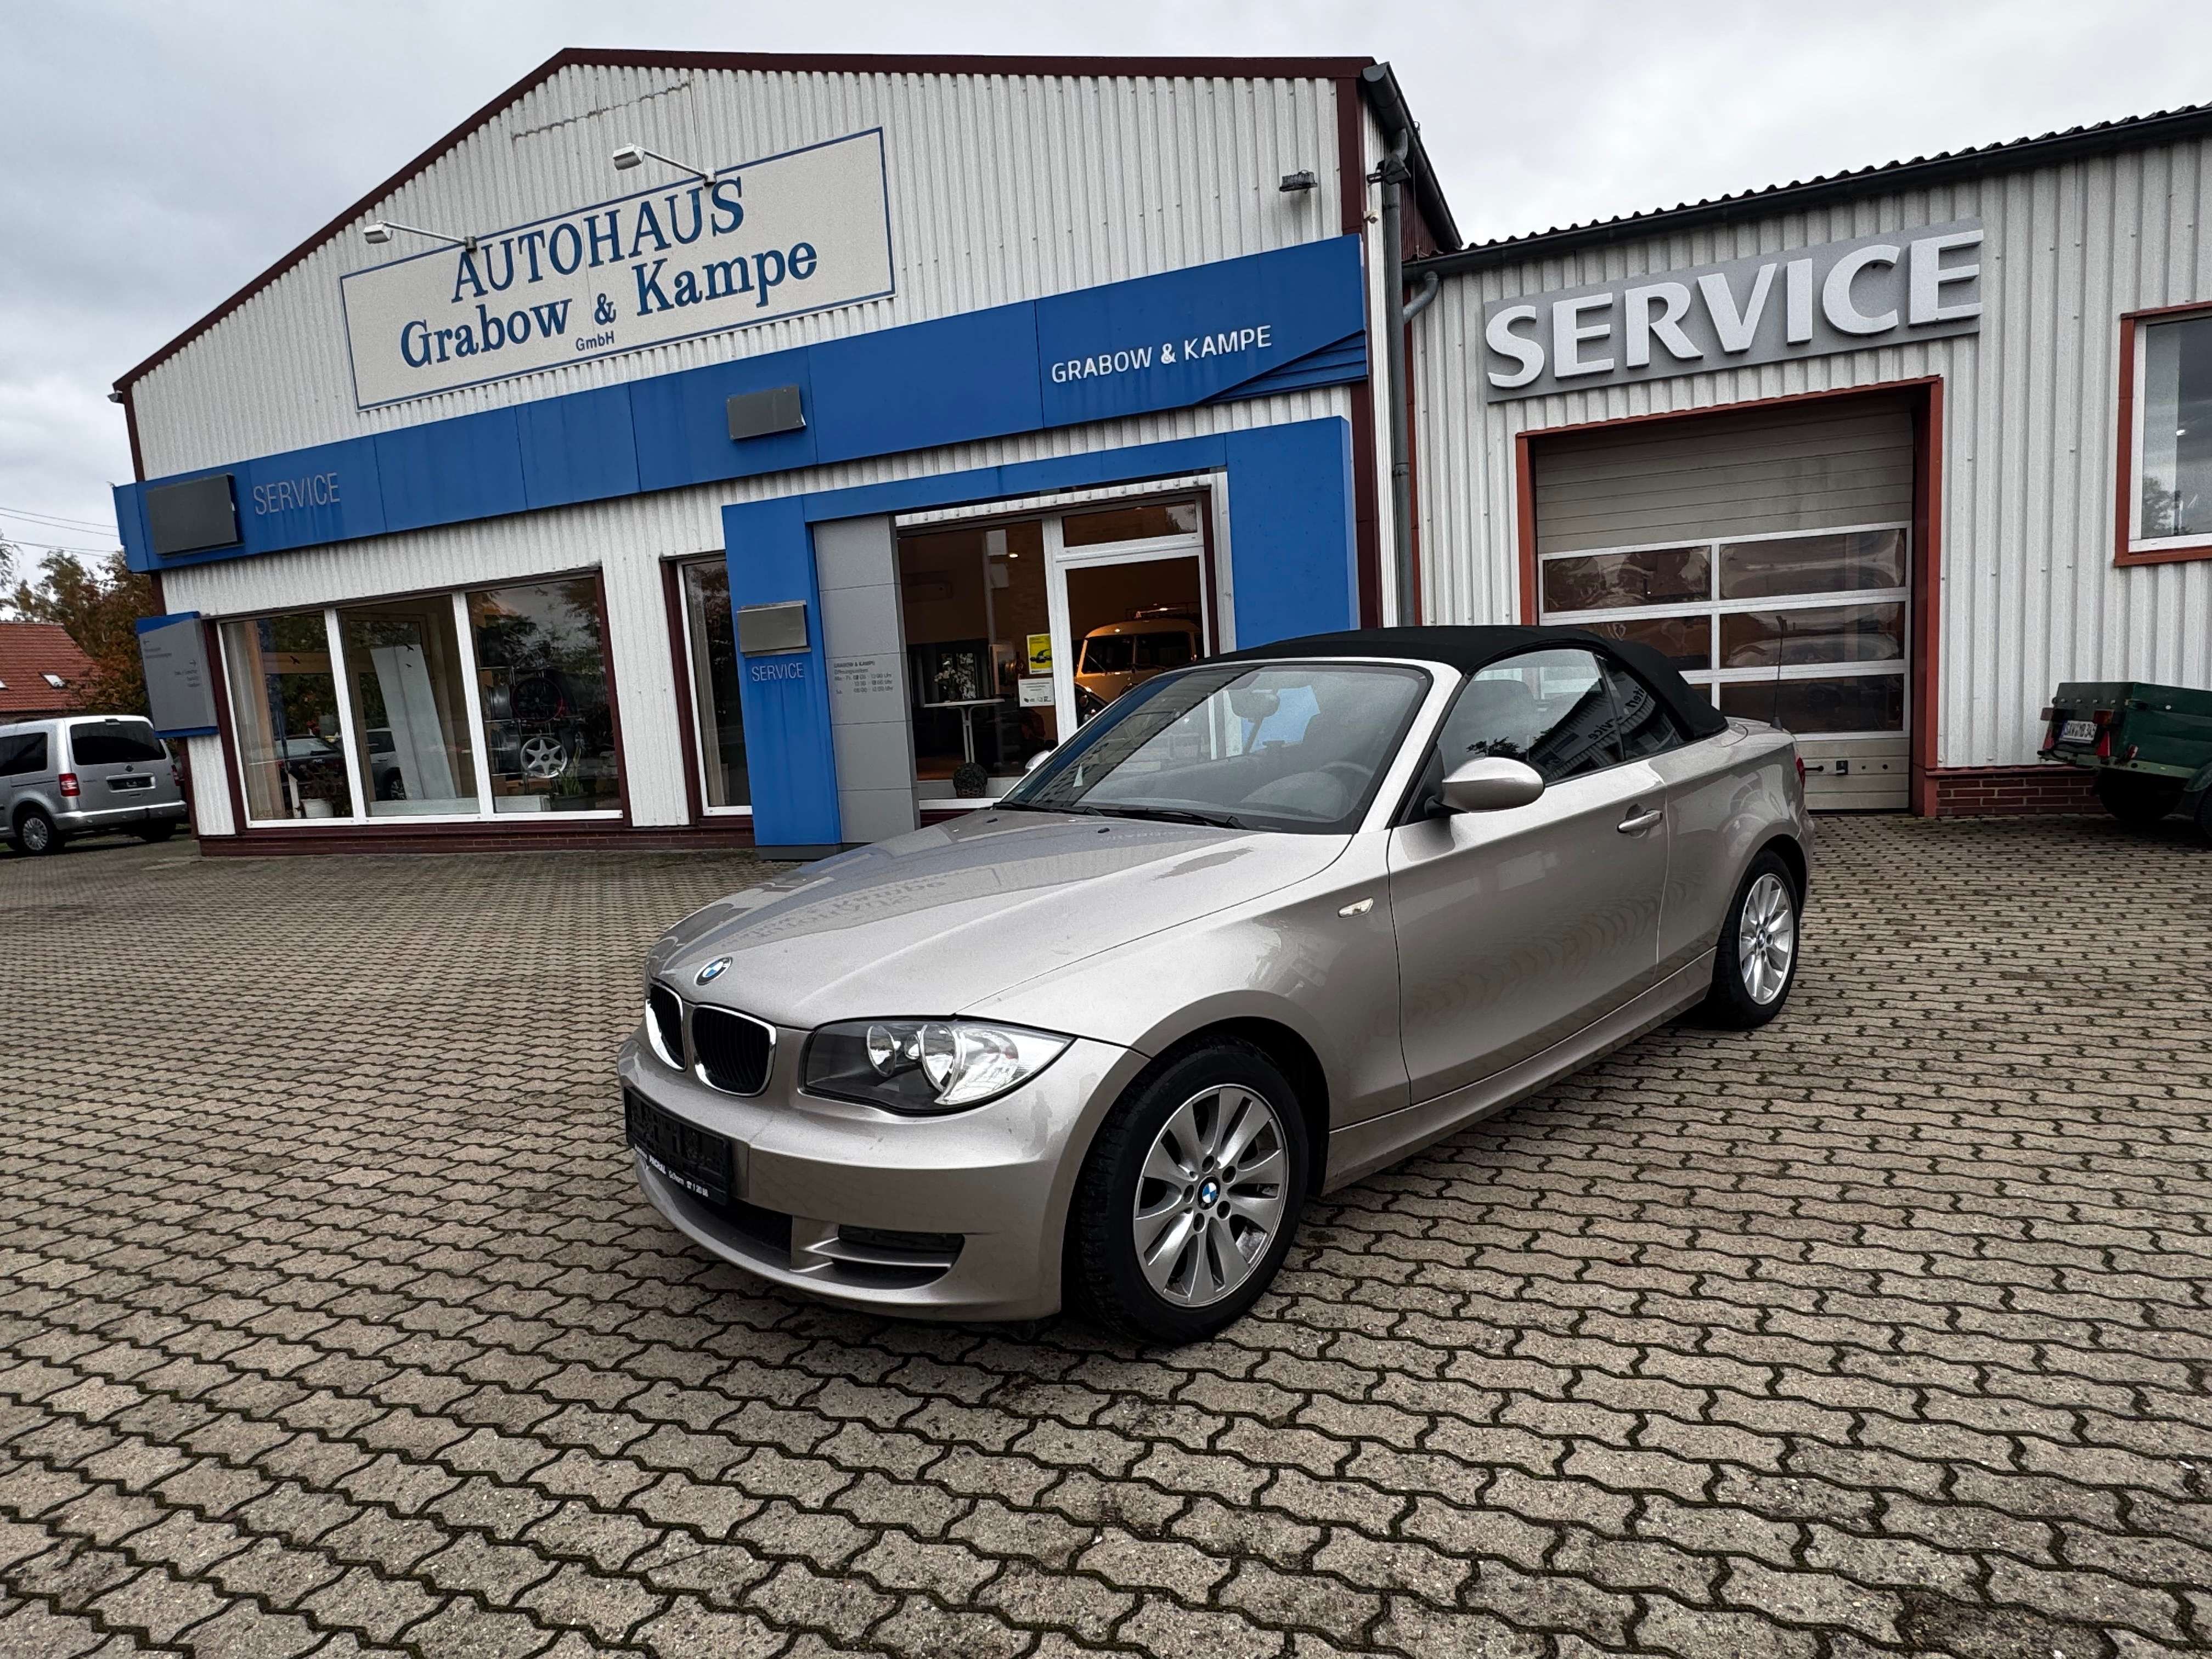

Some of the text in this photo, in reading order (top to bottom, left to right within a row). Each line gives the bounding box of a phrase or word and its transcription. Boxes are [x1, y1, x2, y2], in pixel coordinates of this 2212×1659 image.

[452, 176, 744, 303] AUTOHAUS
[400, 242, 817, 368] Grabow & Kampe
[1486, 229, 1984, 389] SERVICE
[575, 330, 614, 352] GmbH
[1052, 324, 1272, 383] GRABOW & KAMPE
[253, 472, 341, 516] SERVICE
[751, 662, 804, 681] SERVICE
